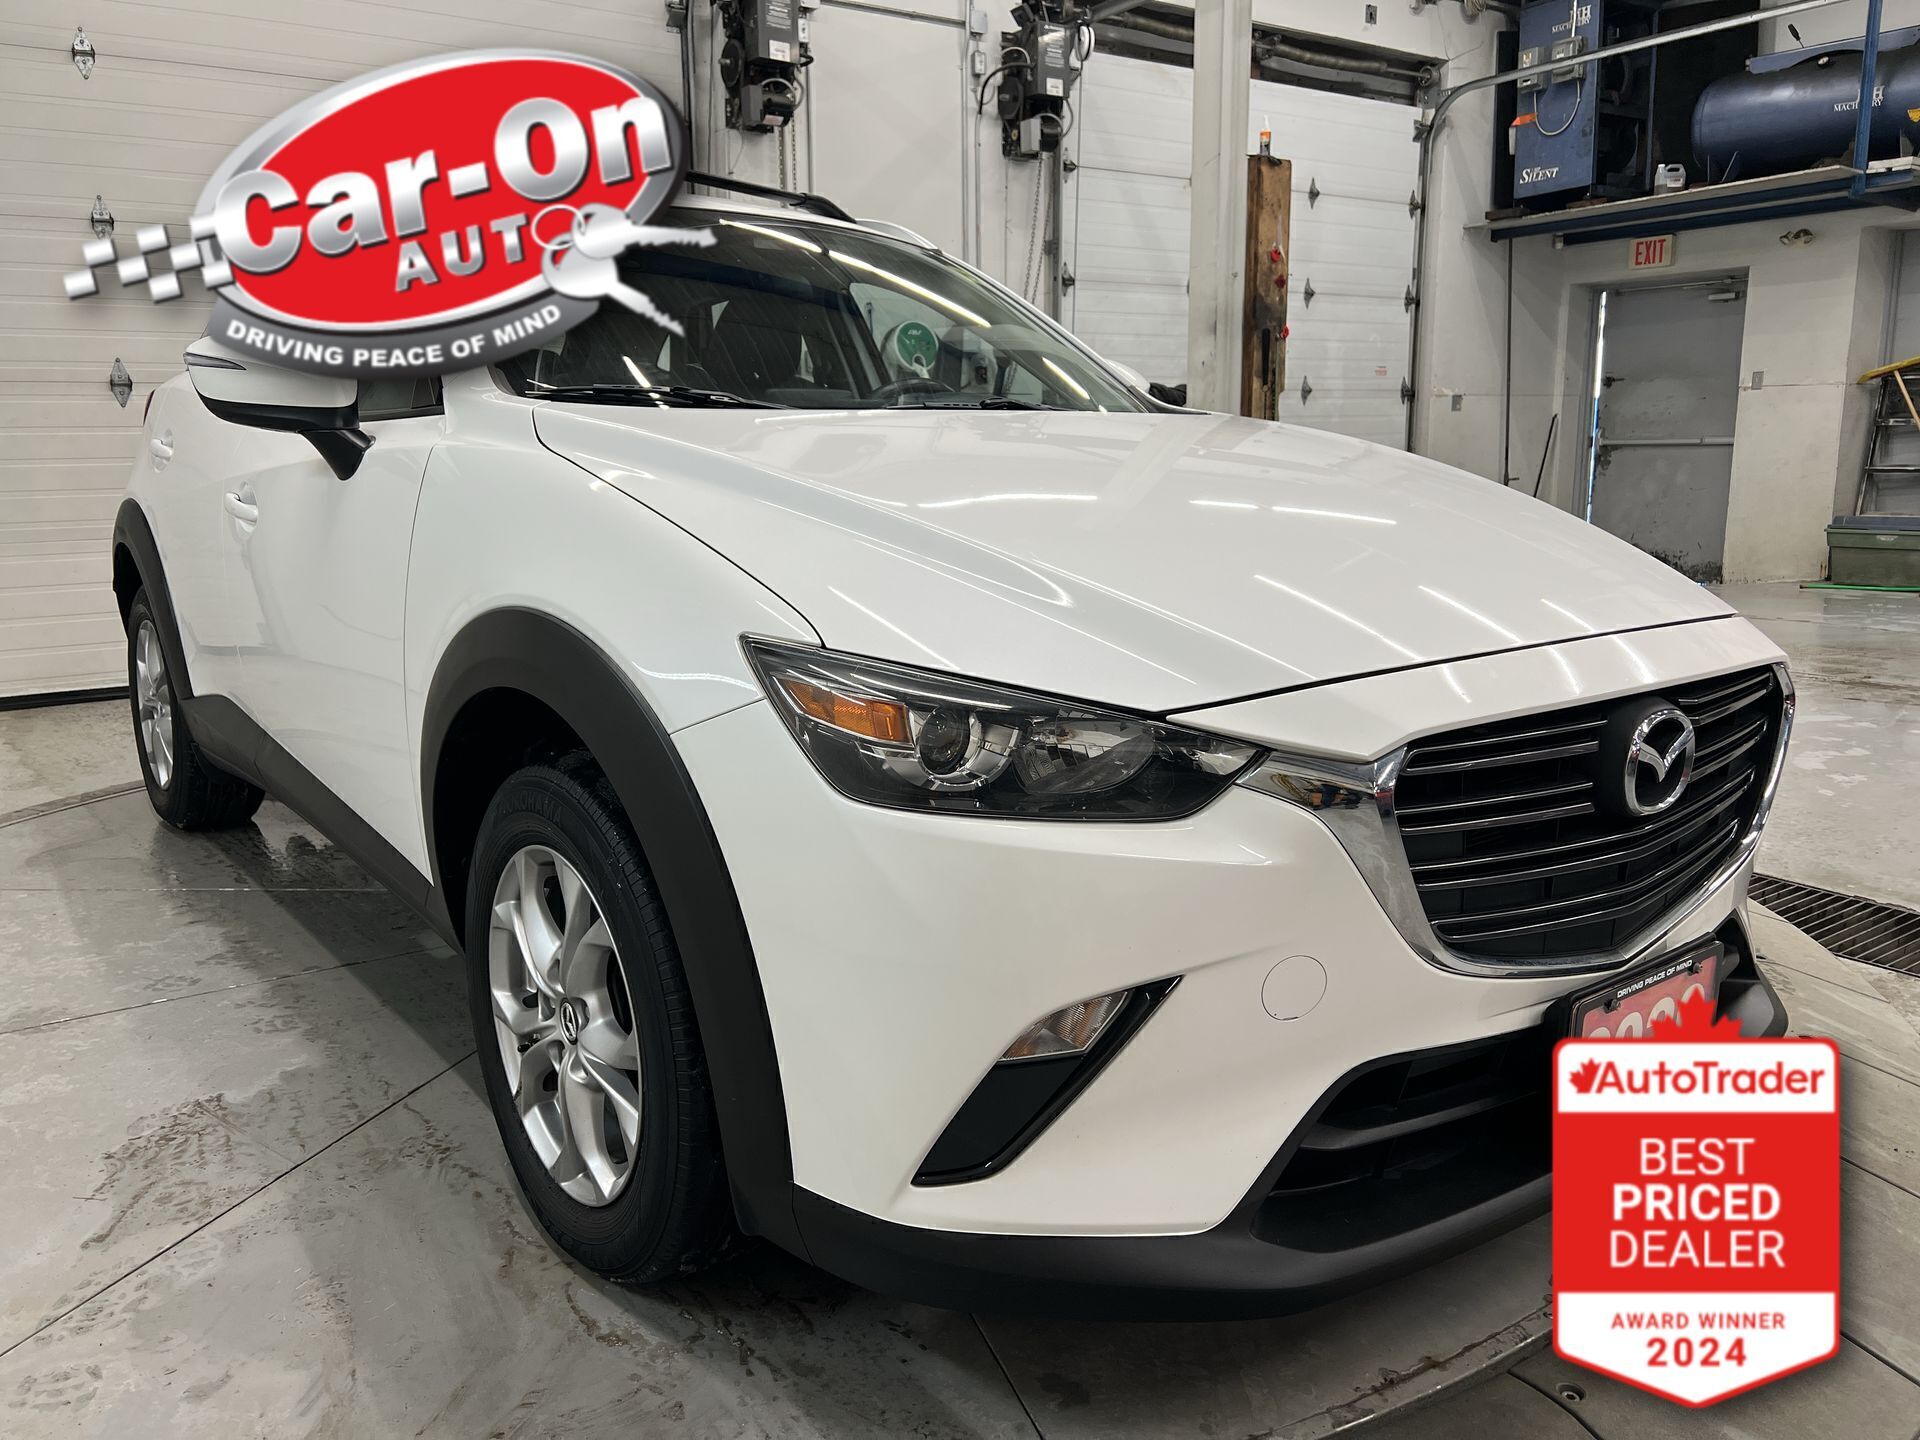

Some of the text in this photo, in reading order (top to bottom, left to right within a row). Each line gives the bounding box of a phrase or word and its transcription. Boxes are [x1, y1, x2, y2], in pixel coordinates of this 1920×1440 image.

[1833, 98, 1884, 112] MACHRY
[1634, 239, 1666, 266] EXIT
[1617, 959, 1692, 998] DRIVING PEACE OF MIND
